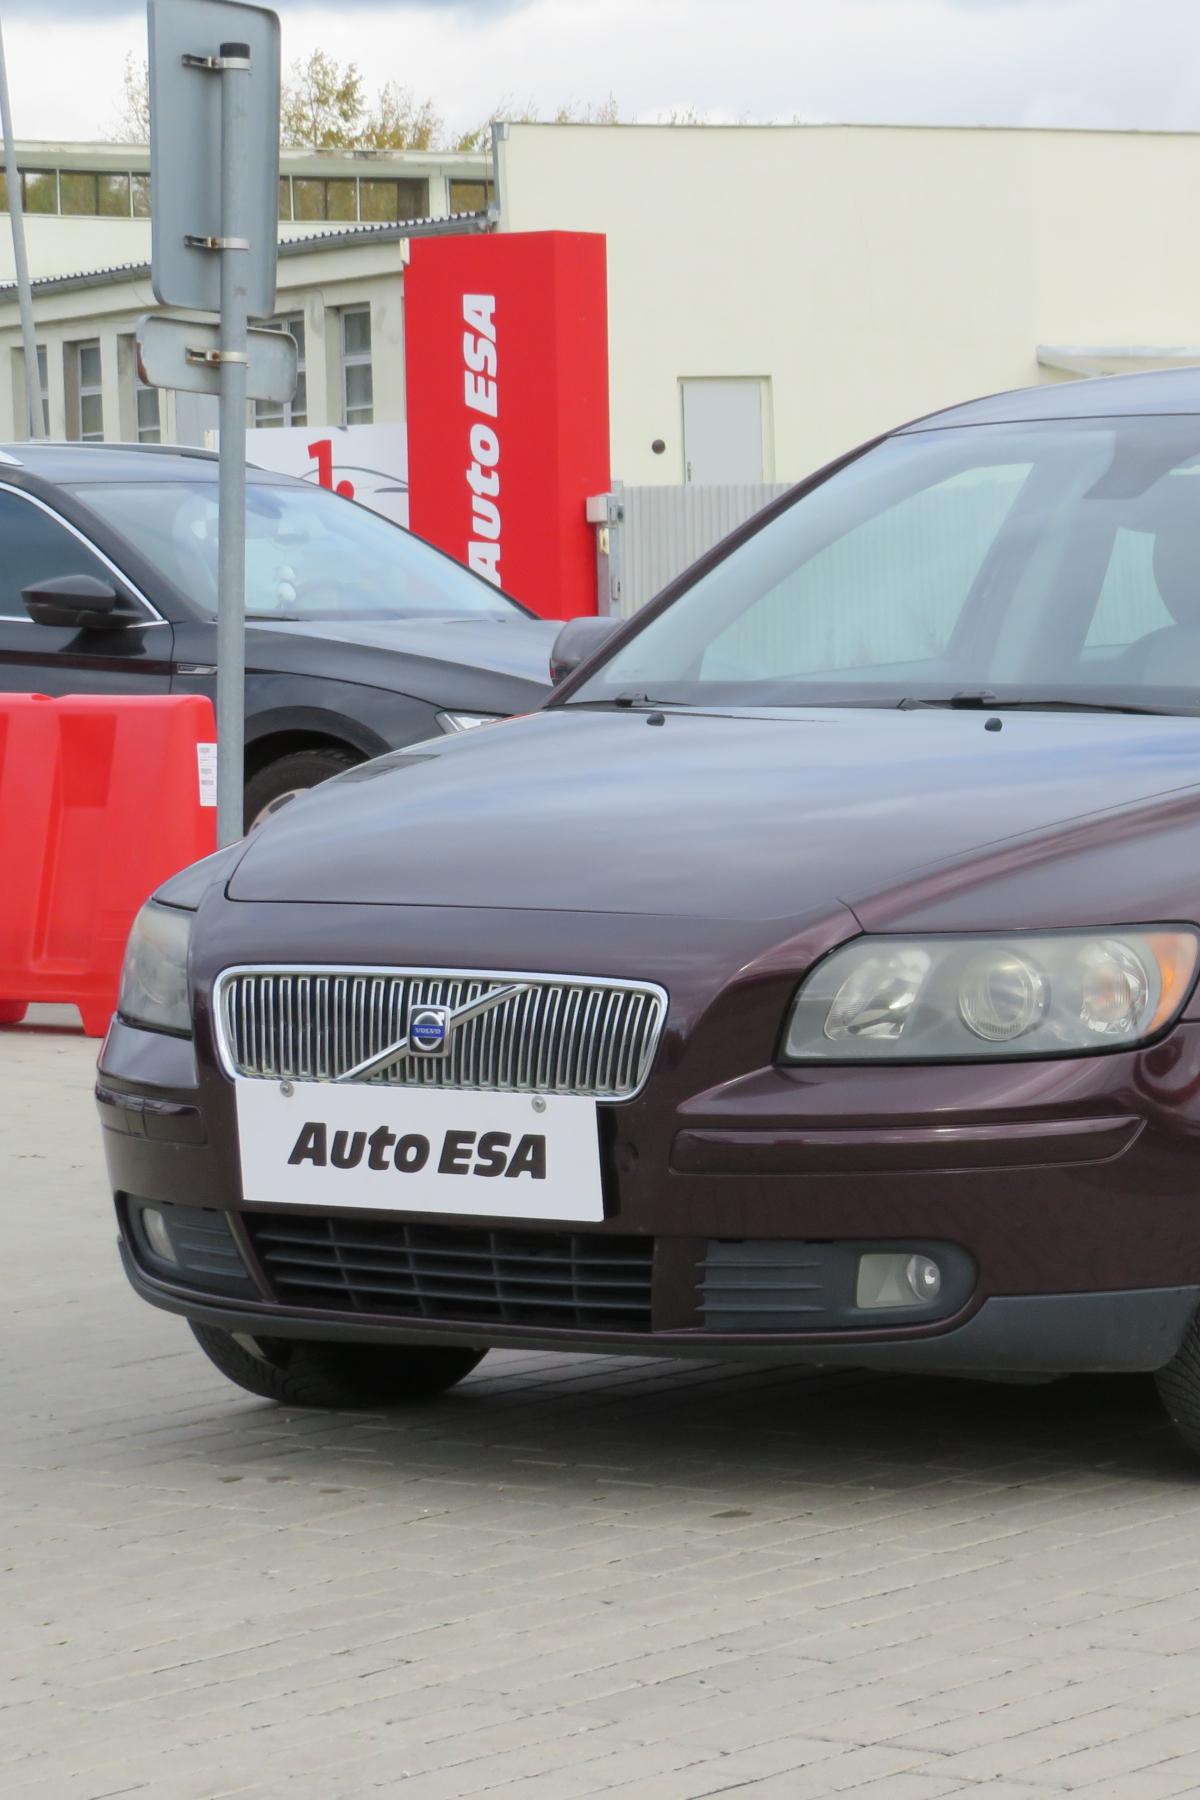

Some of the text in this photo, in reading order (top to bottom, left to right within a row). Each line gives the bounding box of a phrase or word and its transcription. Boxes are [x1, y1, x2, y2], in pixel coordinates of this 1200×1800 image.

[462, 294, 501, 588] Auto ESA
[287, 1121, 547, 1180] Auto ESA
